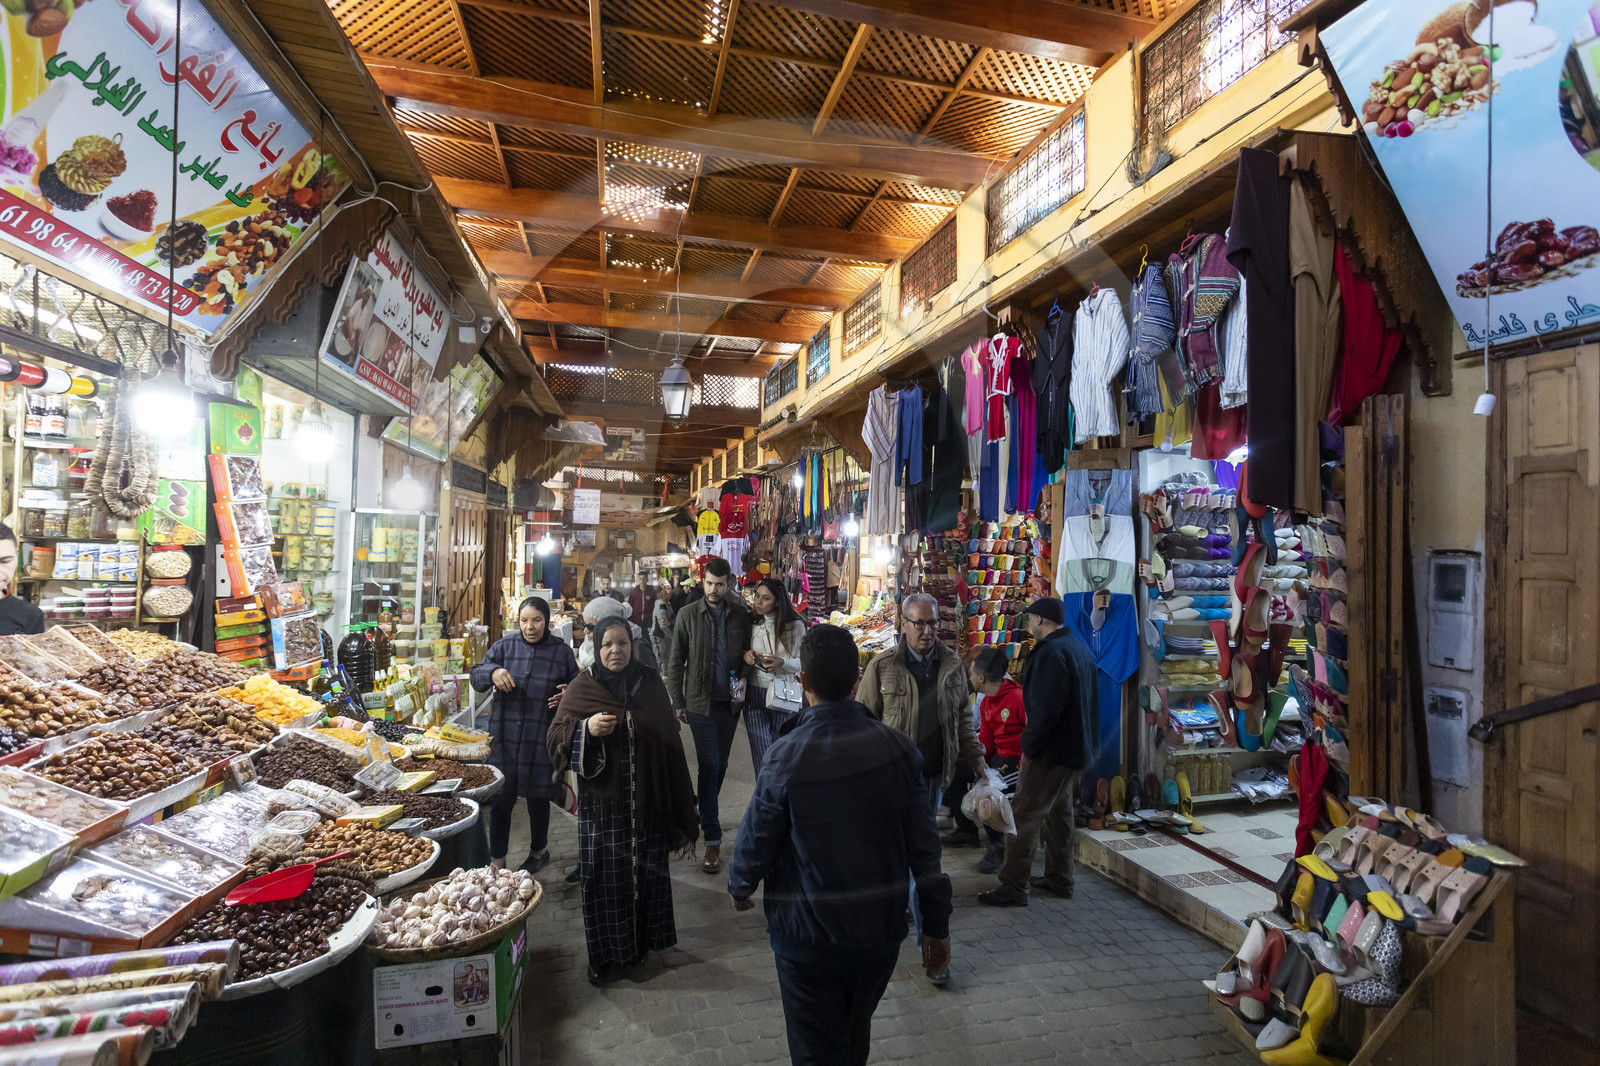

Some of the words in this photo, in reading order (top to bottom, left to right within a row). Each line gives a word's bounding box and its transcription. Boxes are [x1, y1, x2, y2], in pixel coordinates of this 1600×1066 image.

[45, 51, 147, 117] الفيلالي
[117, 0, 240, 111] الفواك
[137, 108, 187, 155] محمد
[220, 109, 285, 171] بائع
[178, 154, 230, 192] صابر
[224, 182, 255, 208] عند
[0, 204, 30, 230] 61
[24, 217, 56, 242] 98
[51, 231, 79, 253] 64
[124, 271, 147, 288] 48
[142, 277, 163, 296] 73
[173, 293, 194, 312] 20
